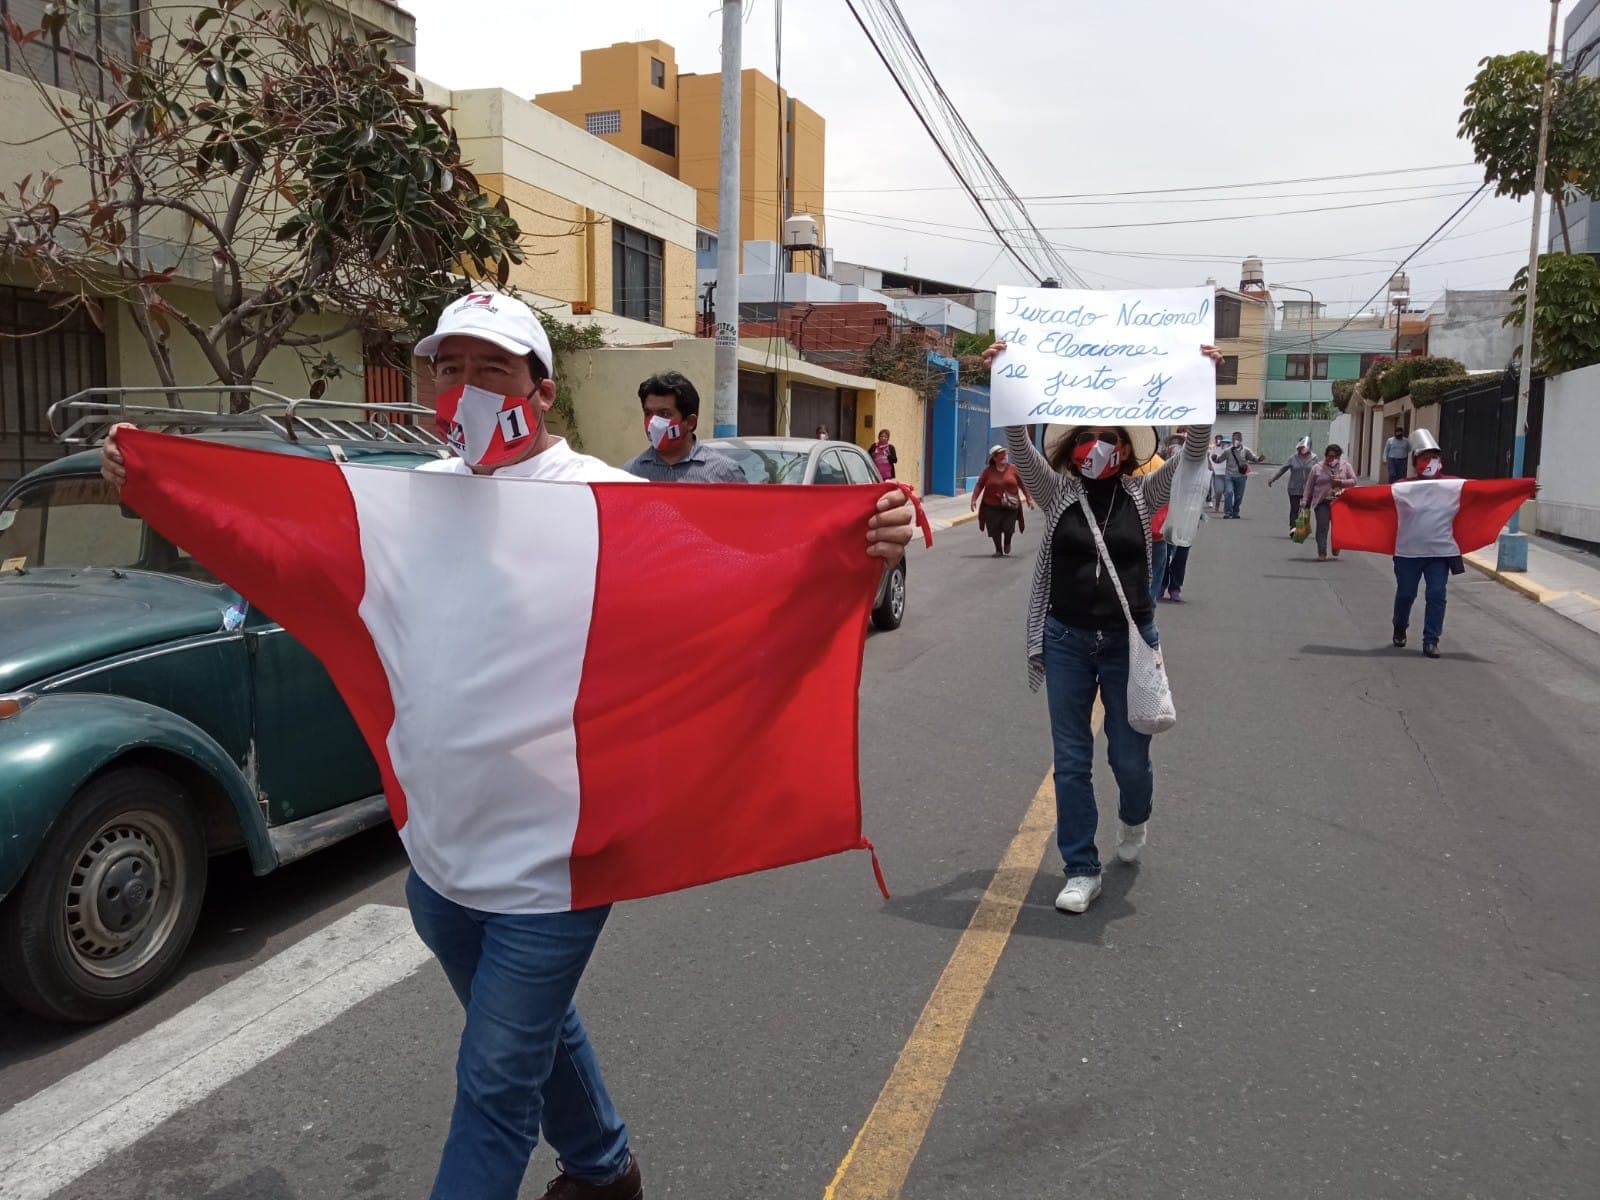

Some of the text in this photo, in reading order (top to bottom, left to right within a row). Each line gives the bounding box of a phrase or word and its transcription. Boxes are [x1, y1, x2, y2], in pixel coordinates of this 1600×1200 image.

[1006, 296, 1209, 328] Jurado Nacional
[1001, 328, 1028, 346] de
[998, 363, 1173, 397] se justo y
[1028, 398, 1197, 420] democrático
[506, 409, 522, 438] 1
[670, 426, 677, 438] 1
